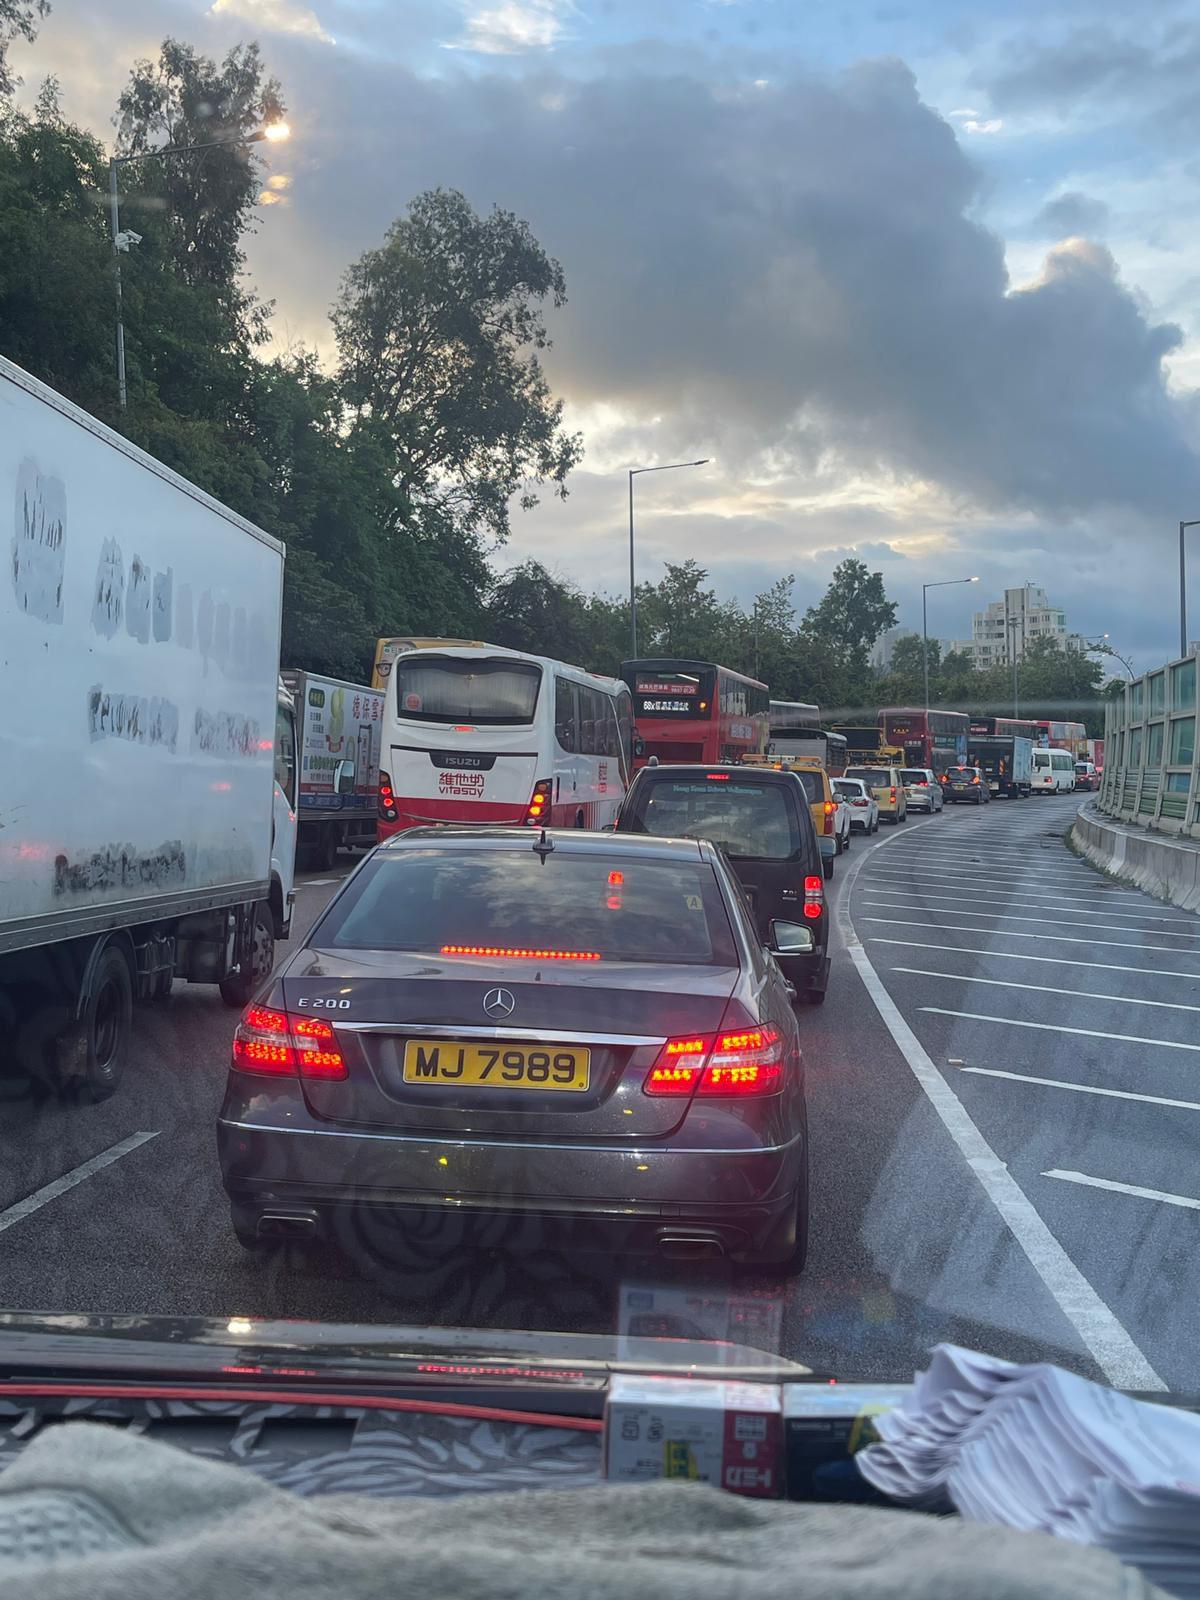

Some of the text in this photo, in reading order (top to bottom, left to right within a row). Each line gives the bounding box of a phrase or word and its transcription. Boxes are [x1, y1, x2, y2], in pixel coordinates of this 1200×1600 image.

[446, 757, 480, 766] ISUZU
[439, 772, 484, 787] 維他奶
[439, 786, 484, 798] vitasoy
[298, 998, 351, 1009] E 200
[414, 1046, 576, 1084] MJ 7989
